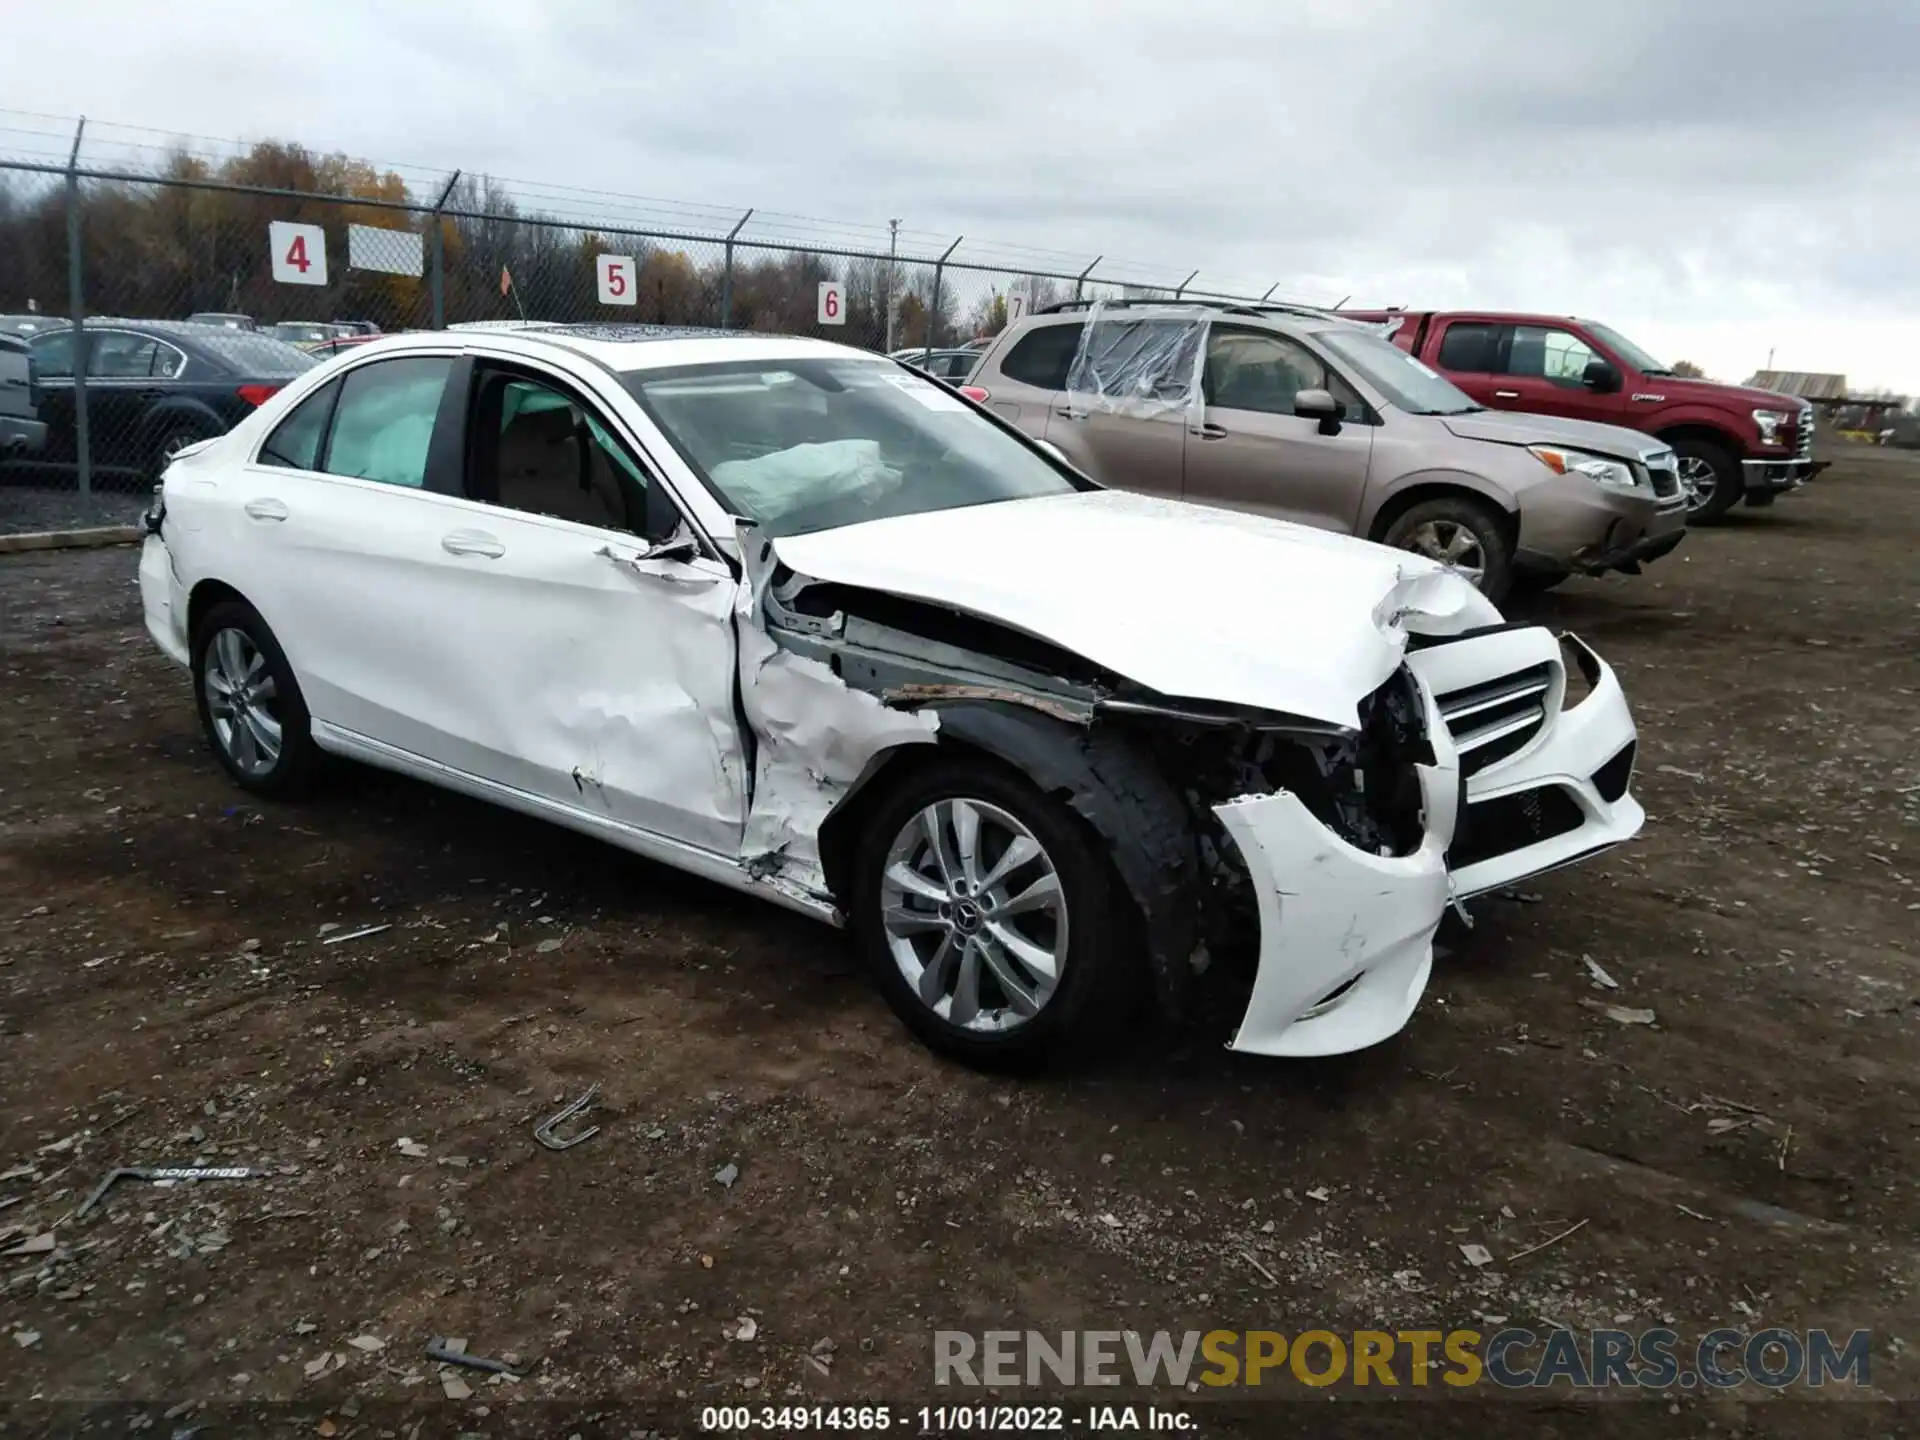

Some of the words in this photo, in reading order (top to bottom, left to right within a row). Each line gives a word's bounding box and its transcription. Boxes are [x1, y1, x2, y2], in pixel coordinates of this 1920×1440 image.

[285, 235, 312, 273] 4
[608, 264, 625, 296] 5
[826, 290, 838, 317] 6
[1013, 297, 1022, 320] 7
